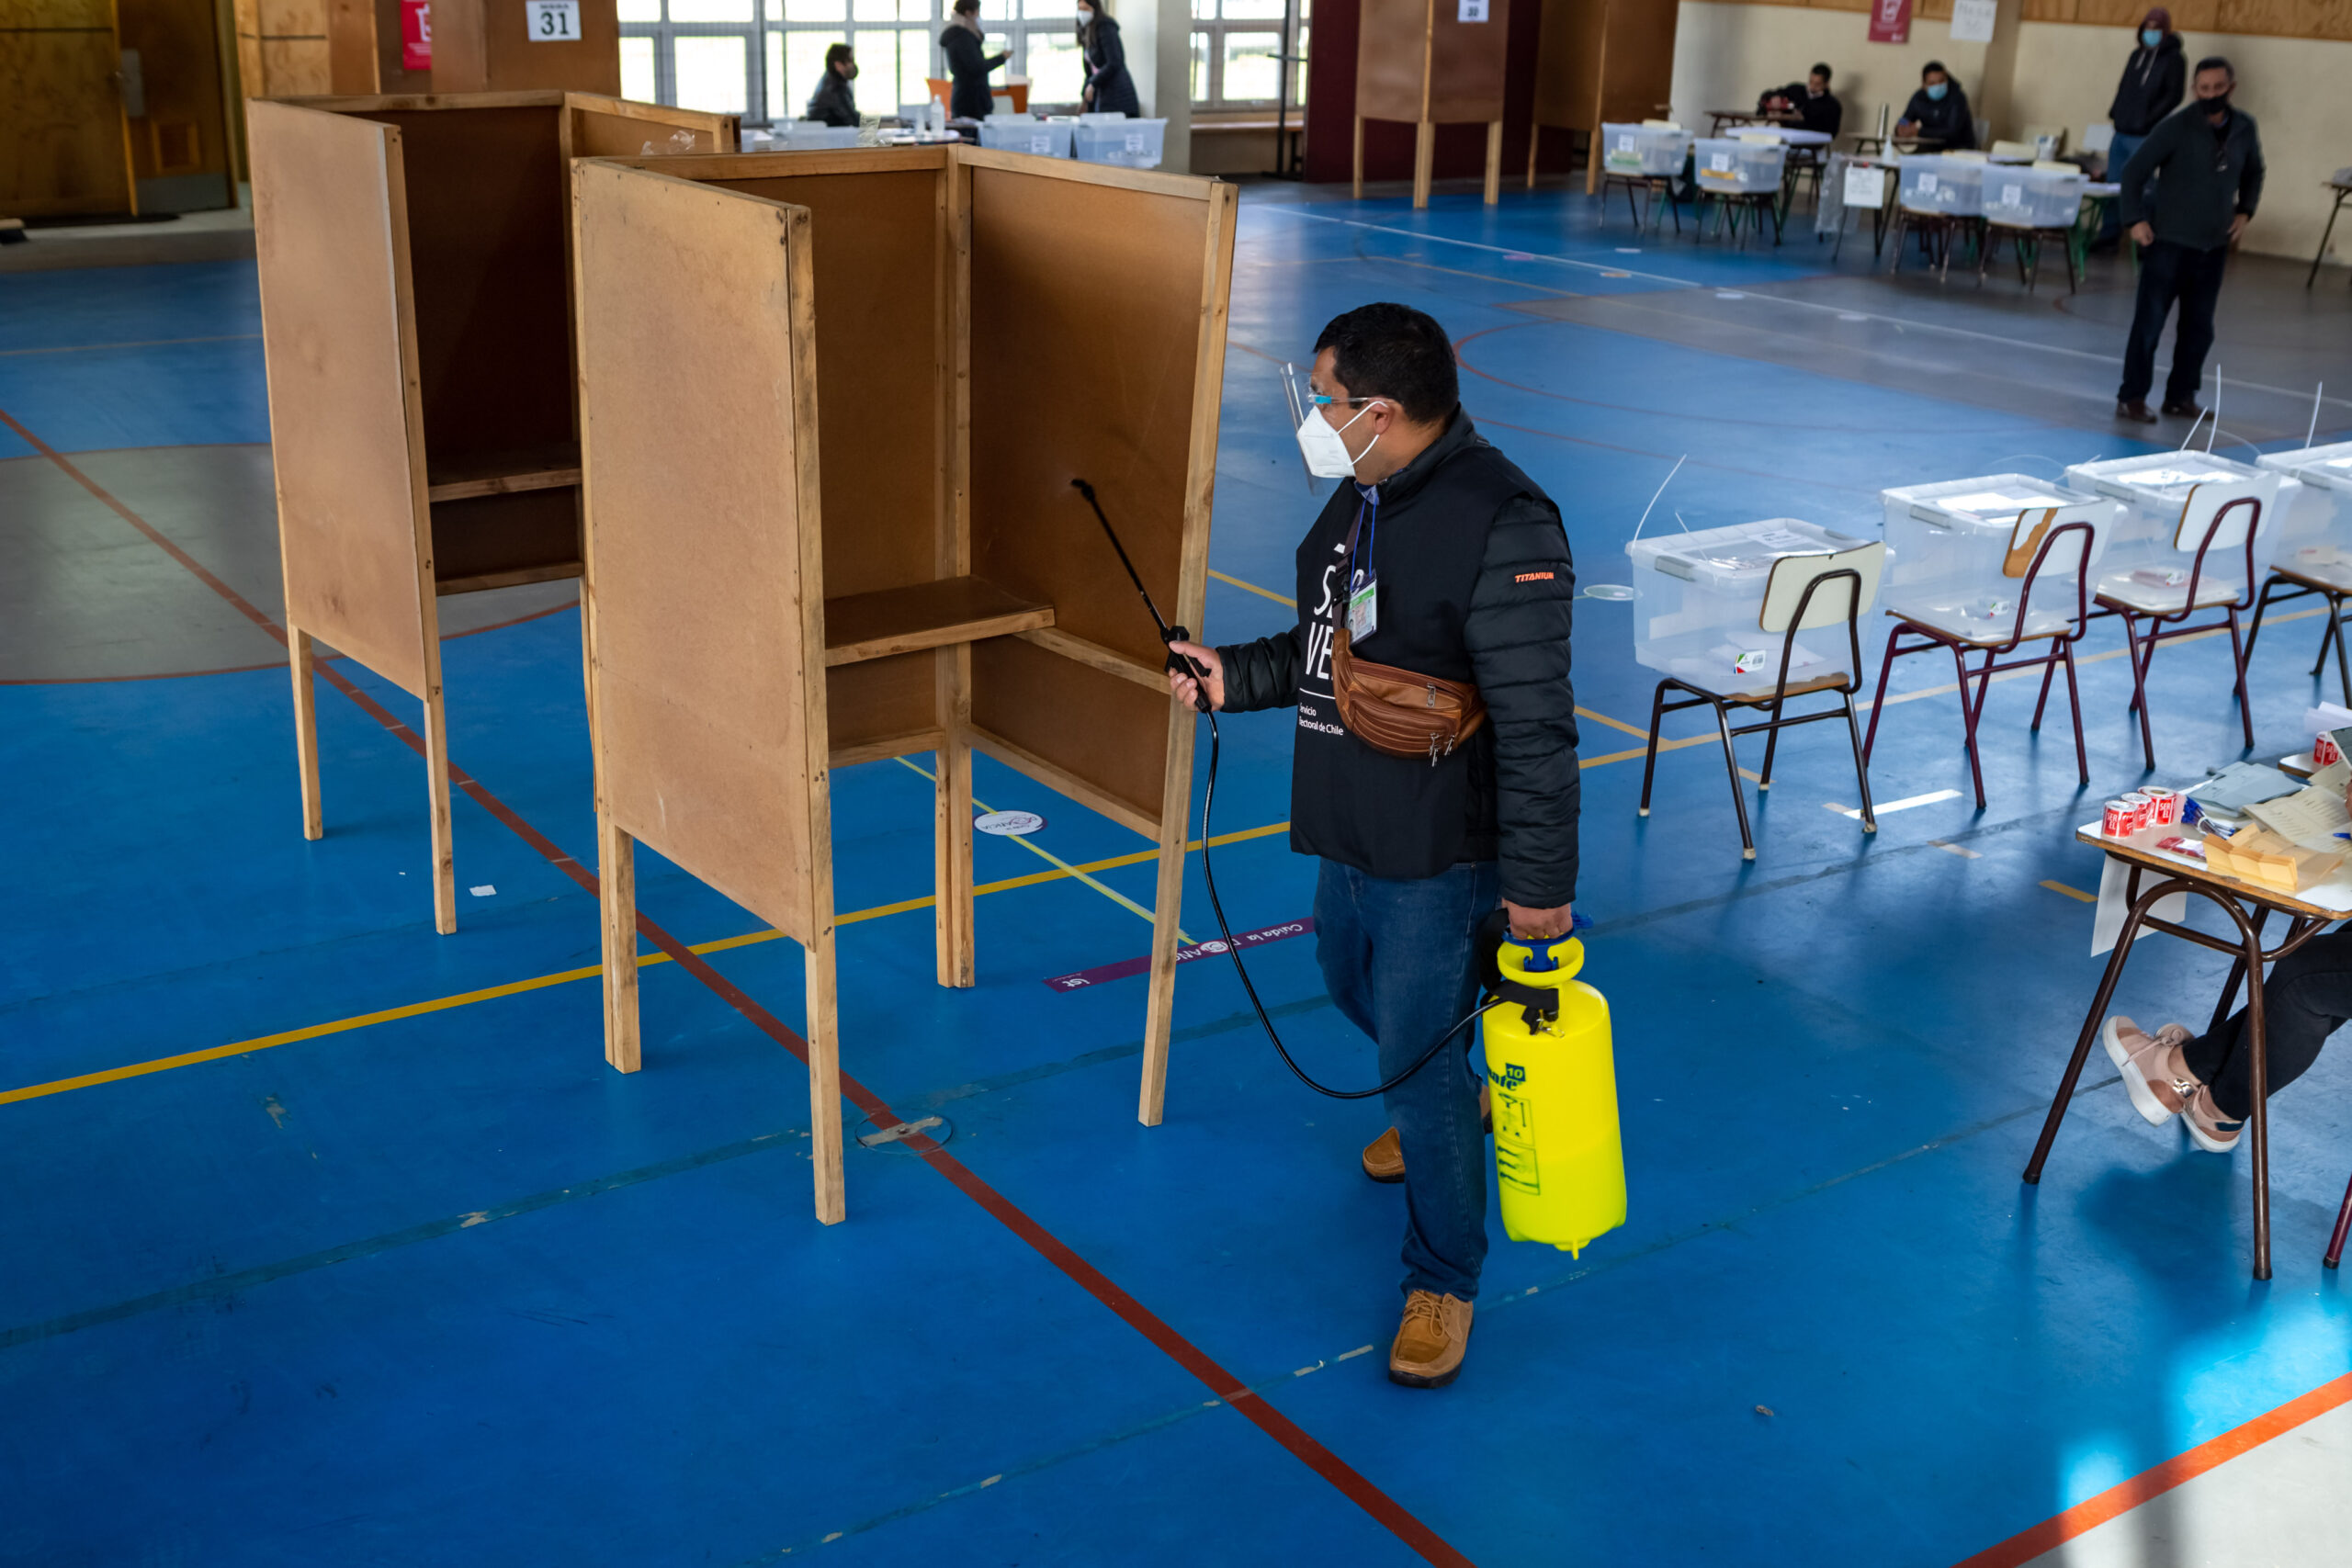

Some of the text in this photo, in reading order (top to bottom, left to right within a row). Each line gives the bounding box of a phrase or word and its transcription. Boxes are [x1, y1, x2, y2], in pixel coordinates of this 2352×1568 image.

[540, 11, 570, 36] 31
[1514, 571, 1555, 583] TITANIUM
[1306, 622, 1334, 681] VE
[1318, 722, 1326, 733] de
[1326, 724, 1344, 736] Chile
[1261, 923, 1303, 937] Cuida
[1507, 1068, 1523, 1079] 10
